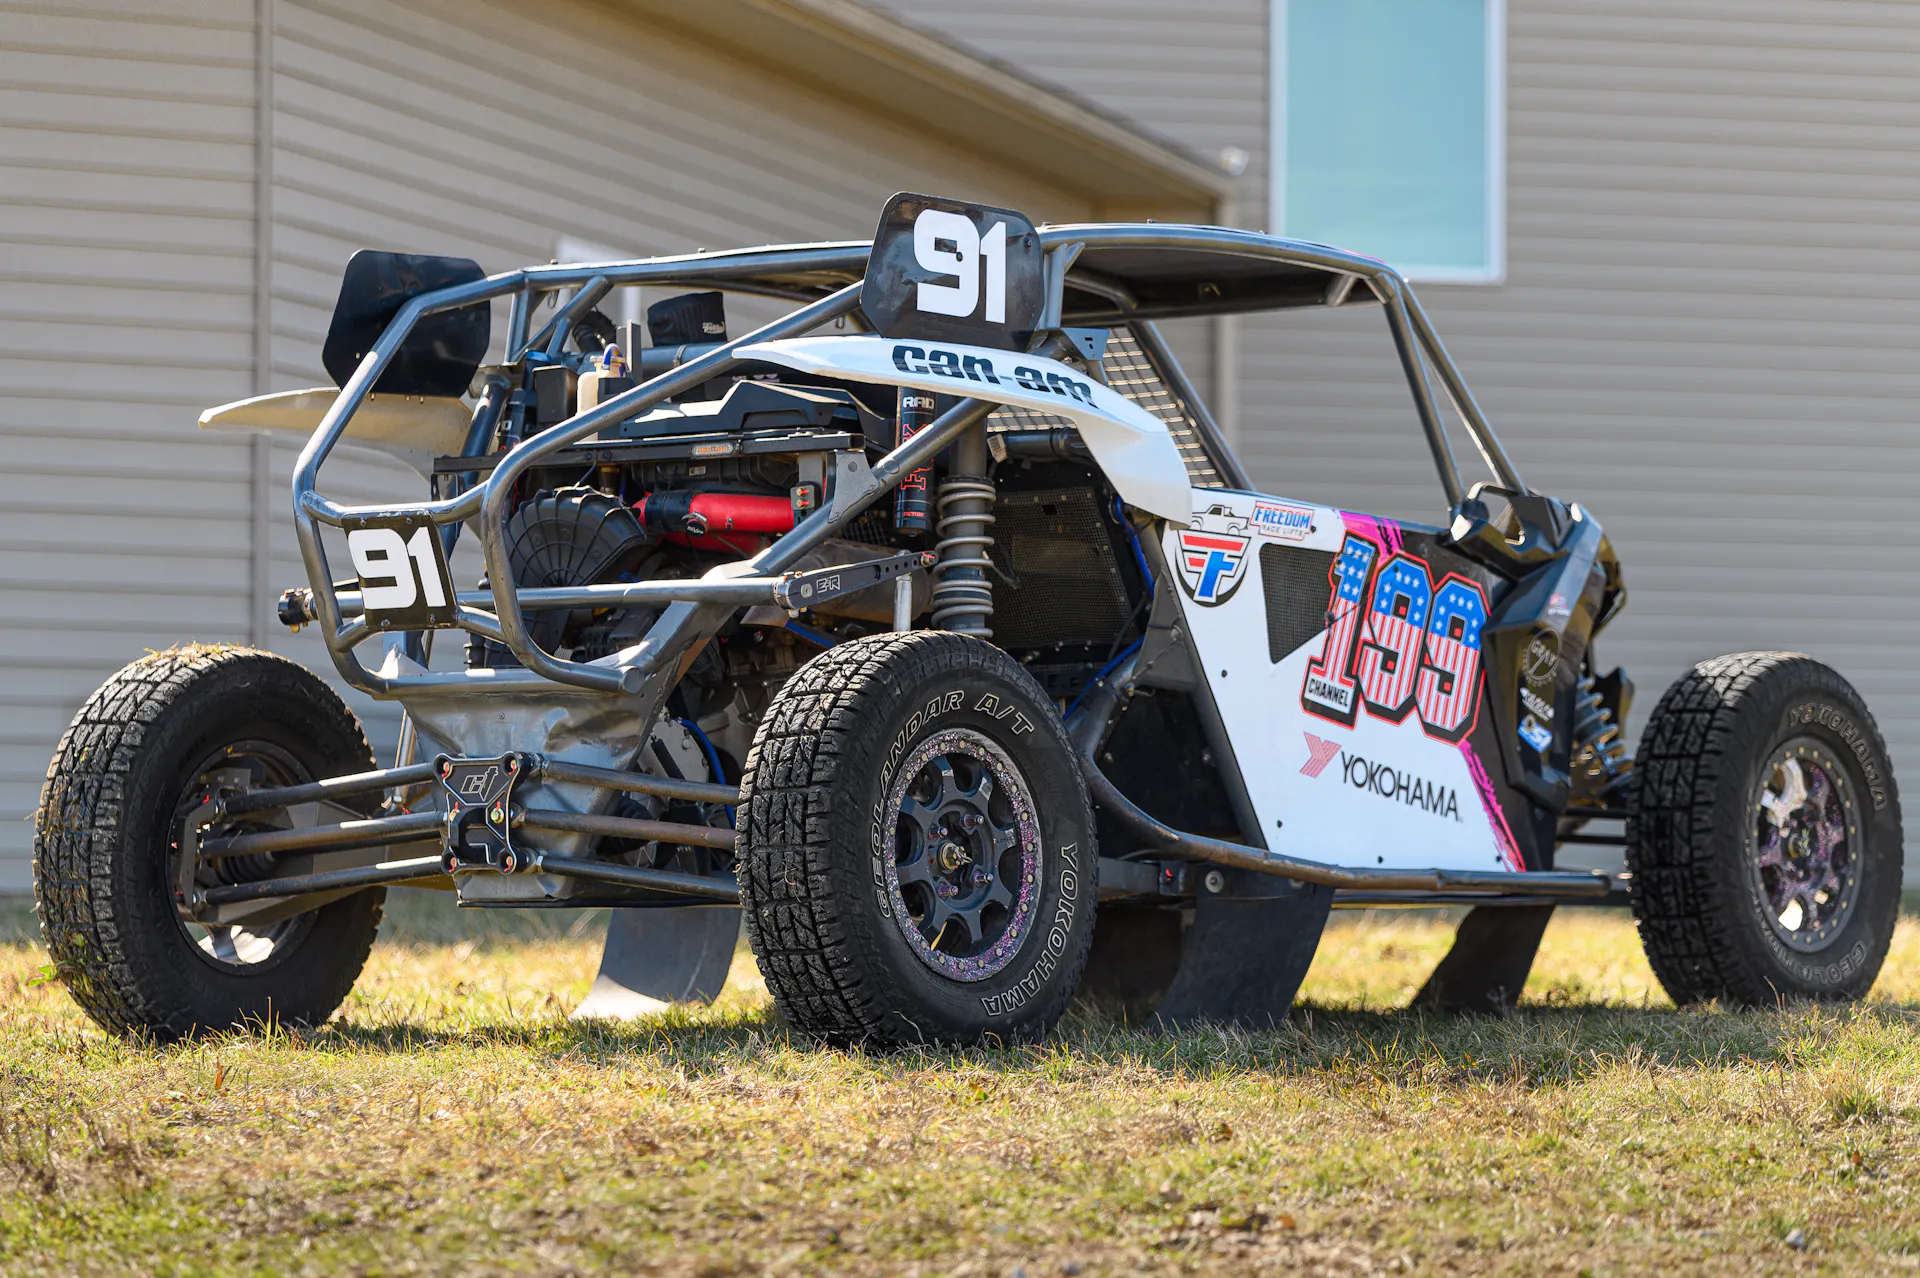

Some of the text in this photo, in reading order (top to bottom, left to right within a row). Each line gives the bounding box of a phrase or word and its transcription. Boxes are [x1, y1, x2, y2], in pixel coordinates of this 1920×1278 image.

[913, 208, 1007, 324] 91
[891, 344, 1099, 409] can-am
[903, 396, 935, 410] RAD
[1254, 505, 1312, 529] FREEDOM
[1262, 524, 1304, 537] RACE LIFTS
[347, 526, 447, 610] 91
[1308, 530, 1491, 747] 199
[1307, 677, 1350, 708] CHANNEL
[1340, 753, 1460, 821] YOKOHAMA
[1789, 702, 1887, 811] YOKOHAMA
[871, 690, 1035, 920] GEOLANDAR A/T
[981, 841, 1078, 1017] YOKOHAMA
